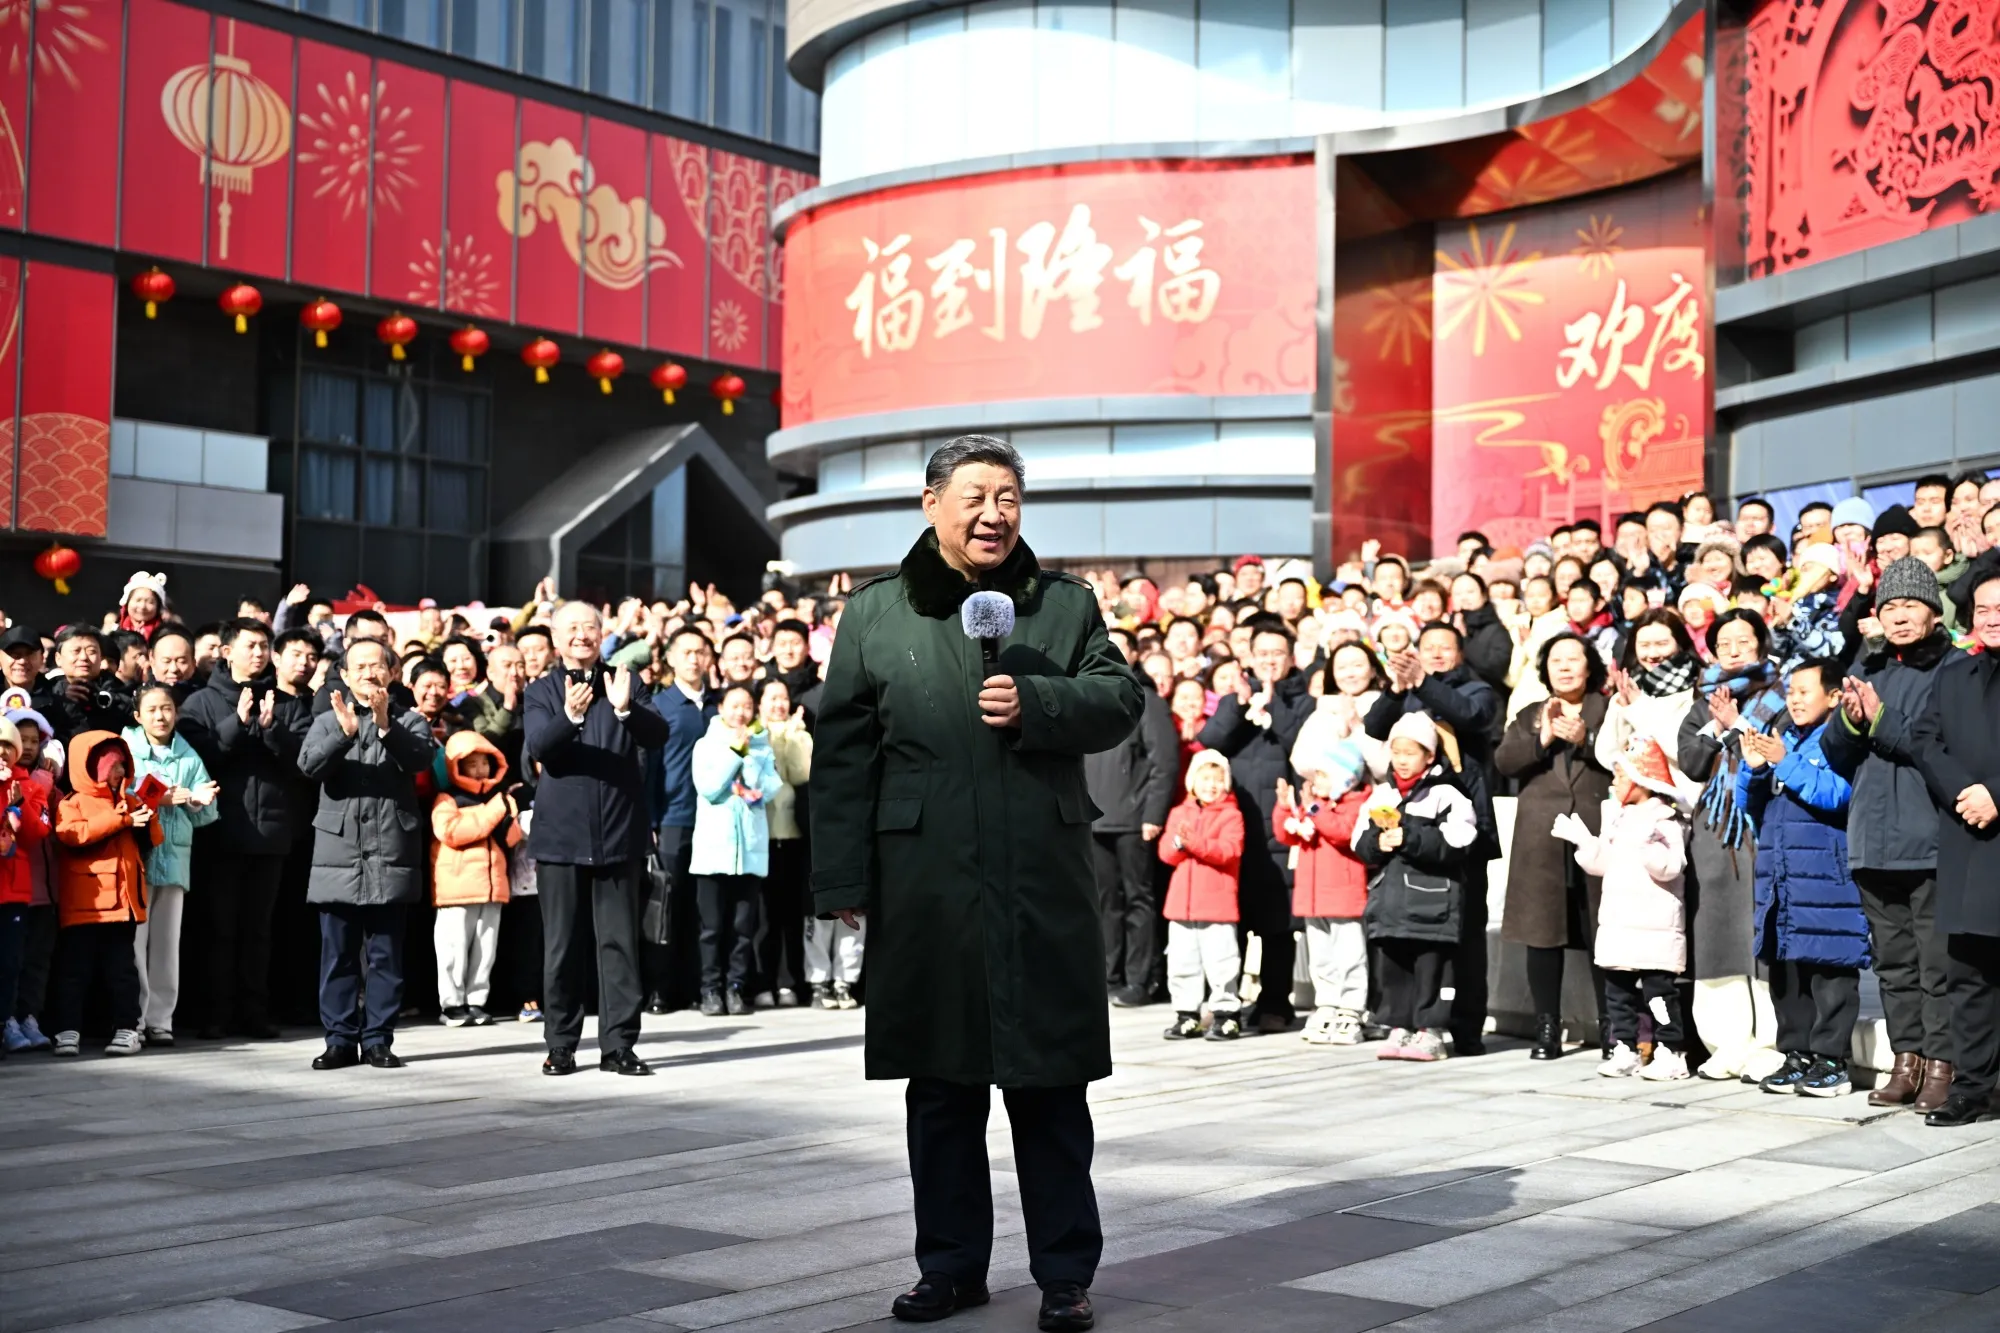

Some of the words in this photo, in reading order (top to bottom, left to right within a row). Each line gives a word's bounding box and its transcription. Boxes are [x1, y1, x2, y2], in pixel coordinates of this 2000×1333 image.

[845, 203, 1221, 359] 福到隆福
[1556, 273, 1705, 391] 欢度
